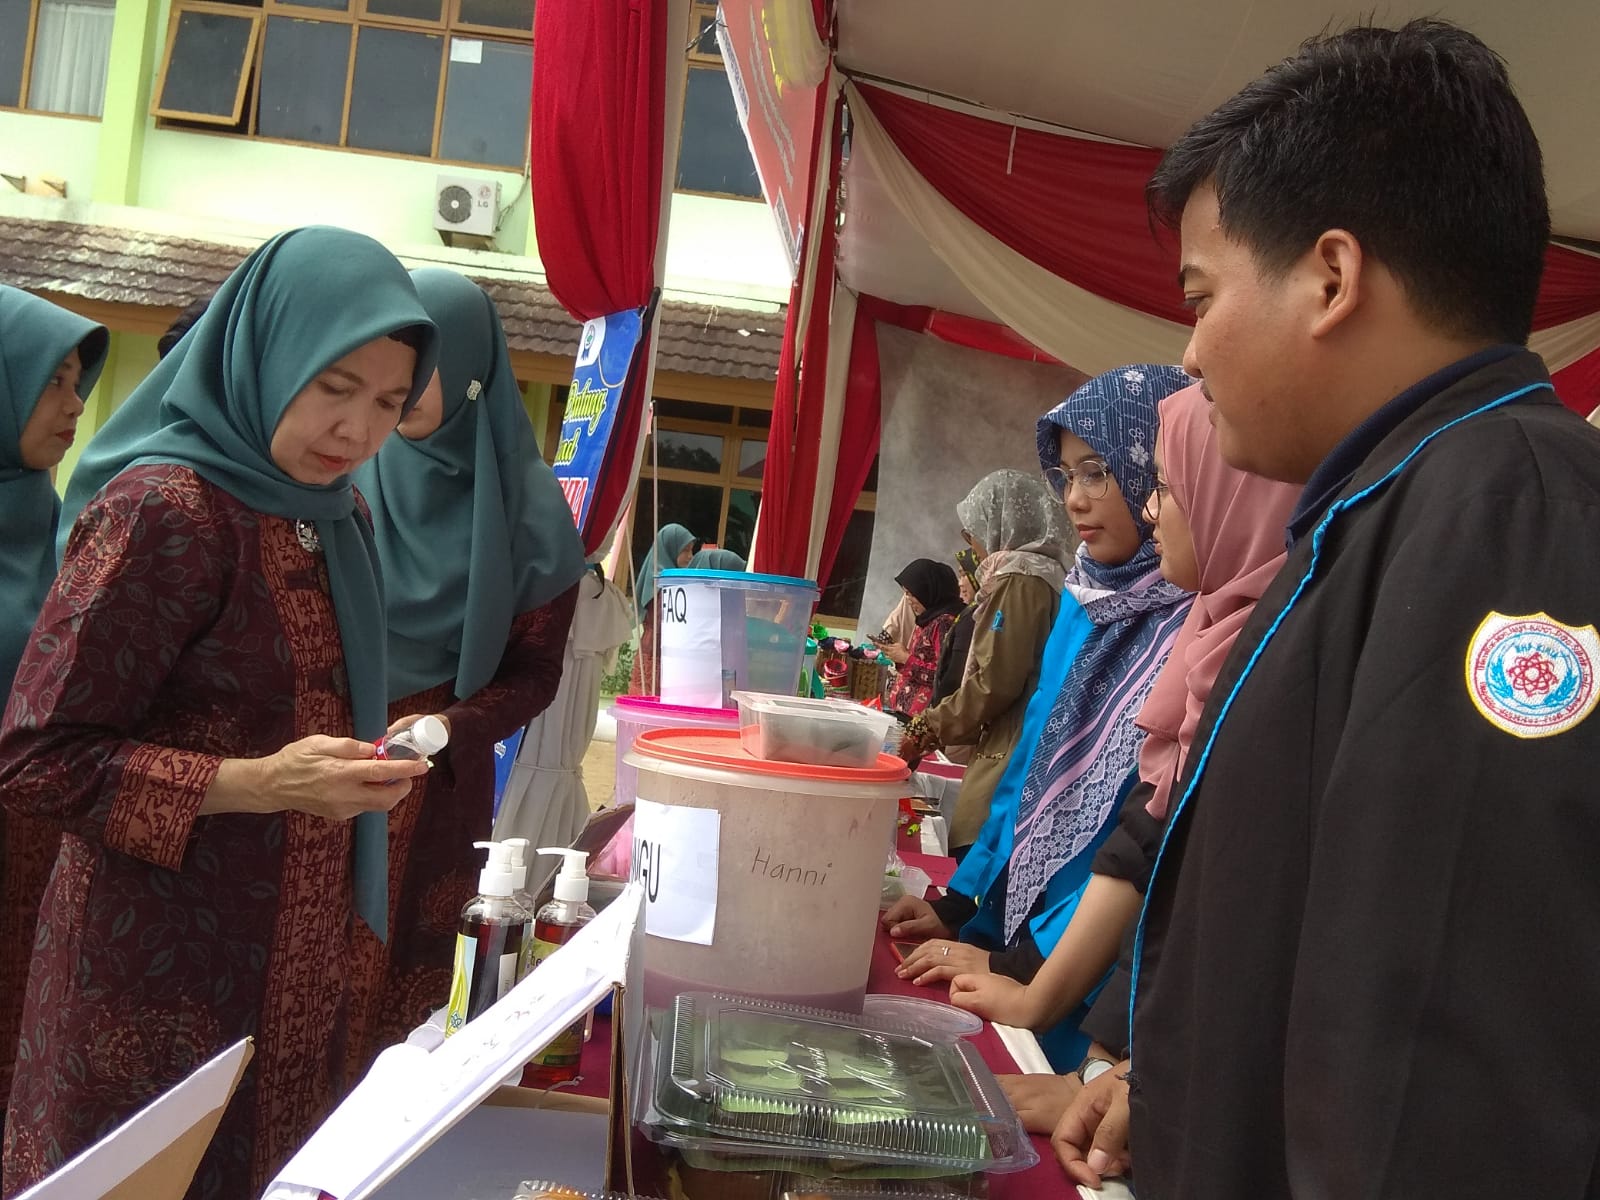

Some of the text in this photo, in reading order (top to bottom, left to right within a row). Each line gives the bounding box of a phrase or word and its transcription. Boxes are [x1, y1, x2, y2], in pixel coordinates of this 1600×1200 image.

[478, 200, 489, 209] LG
[662, 587, 687, 624] FAQ
[751, 846, 833, 886] Hanni
